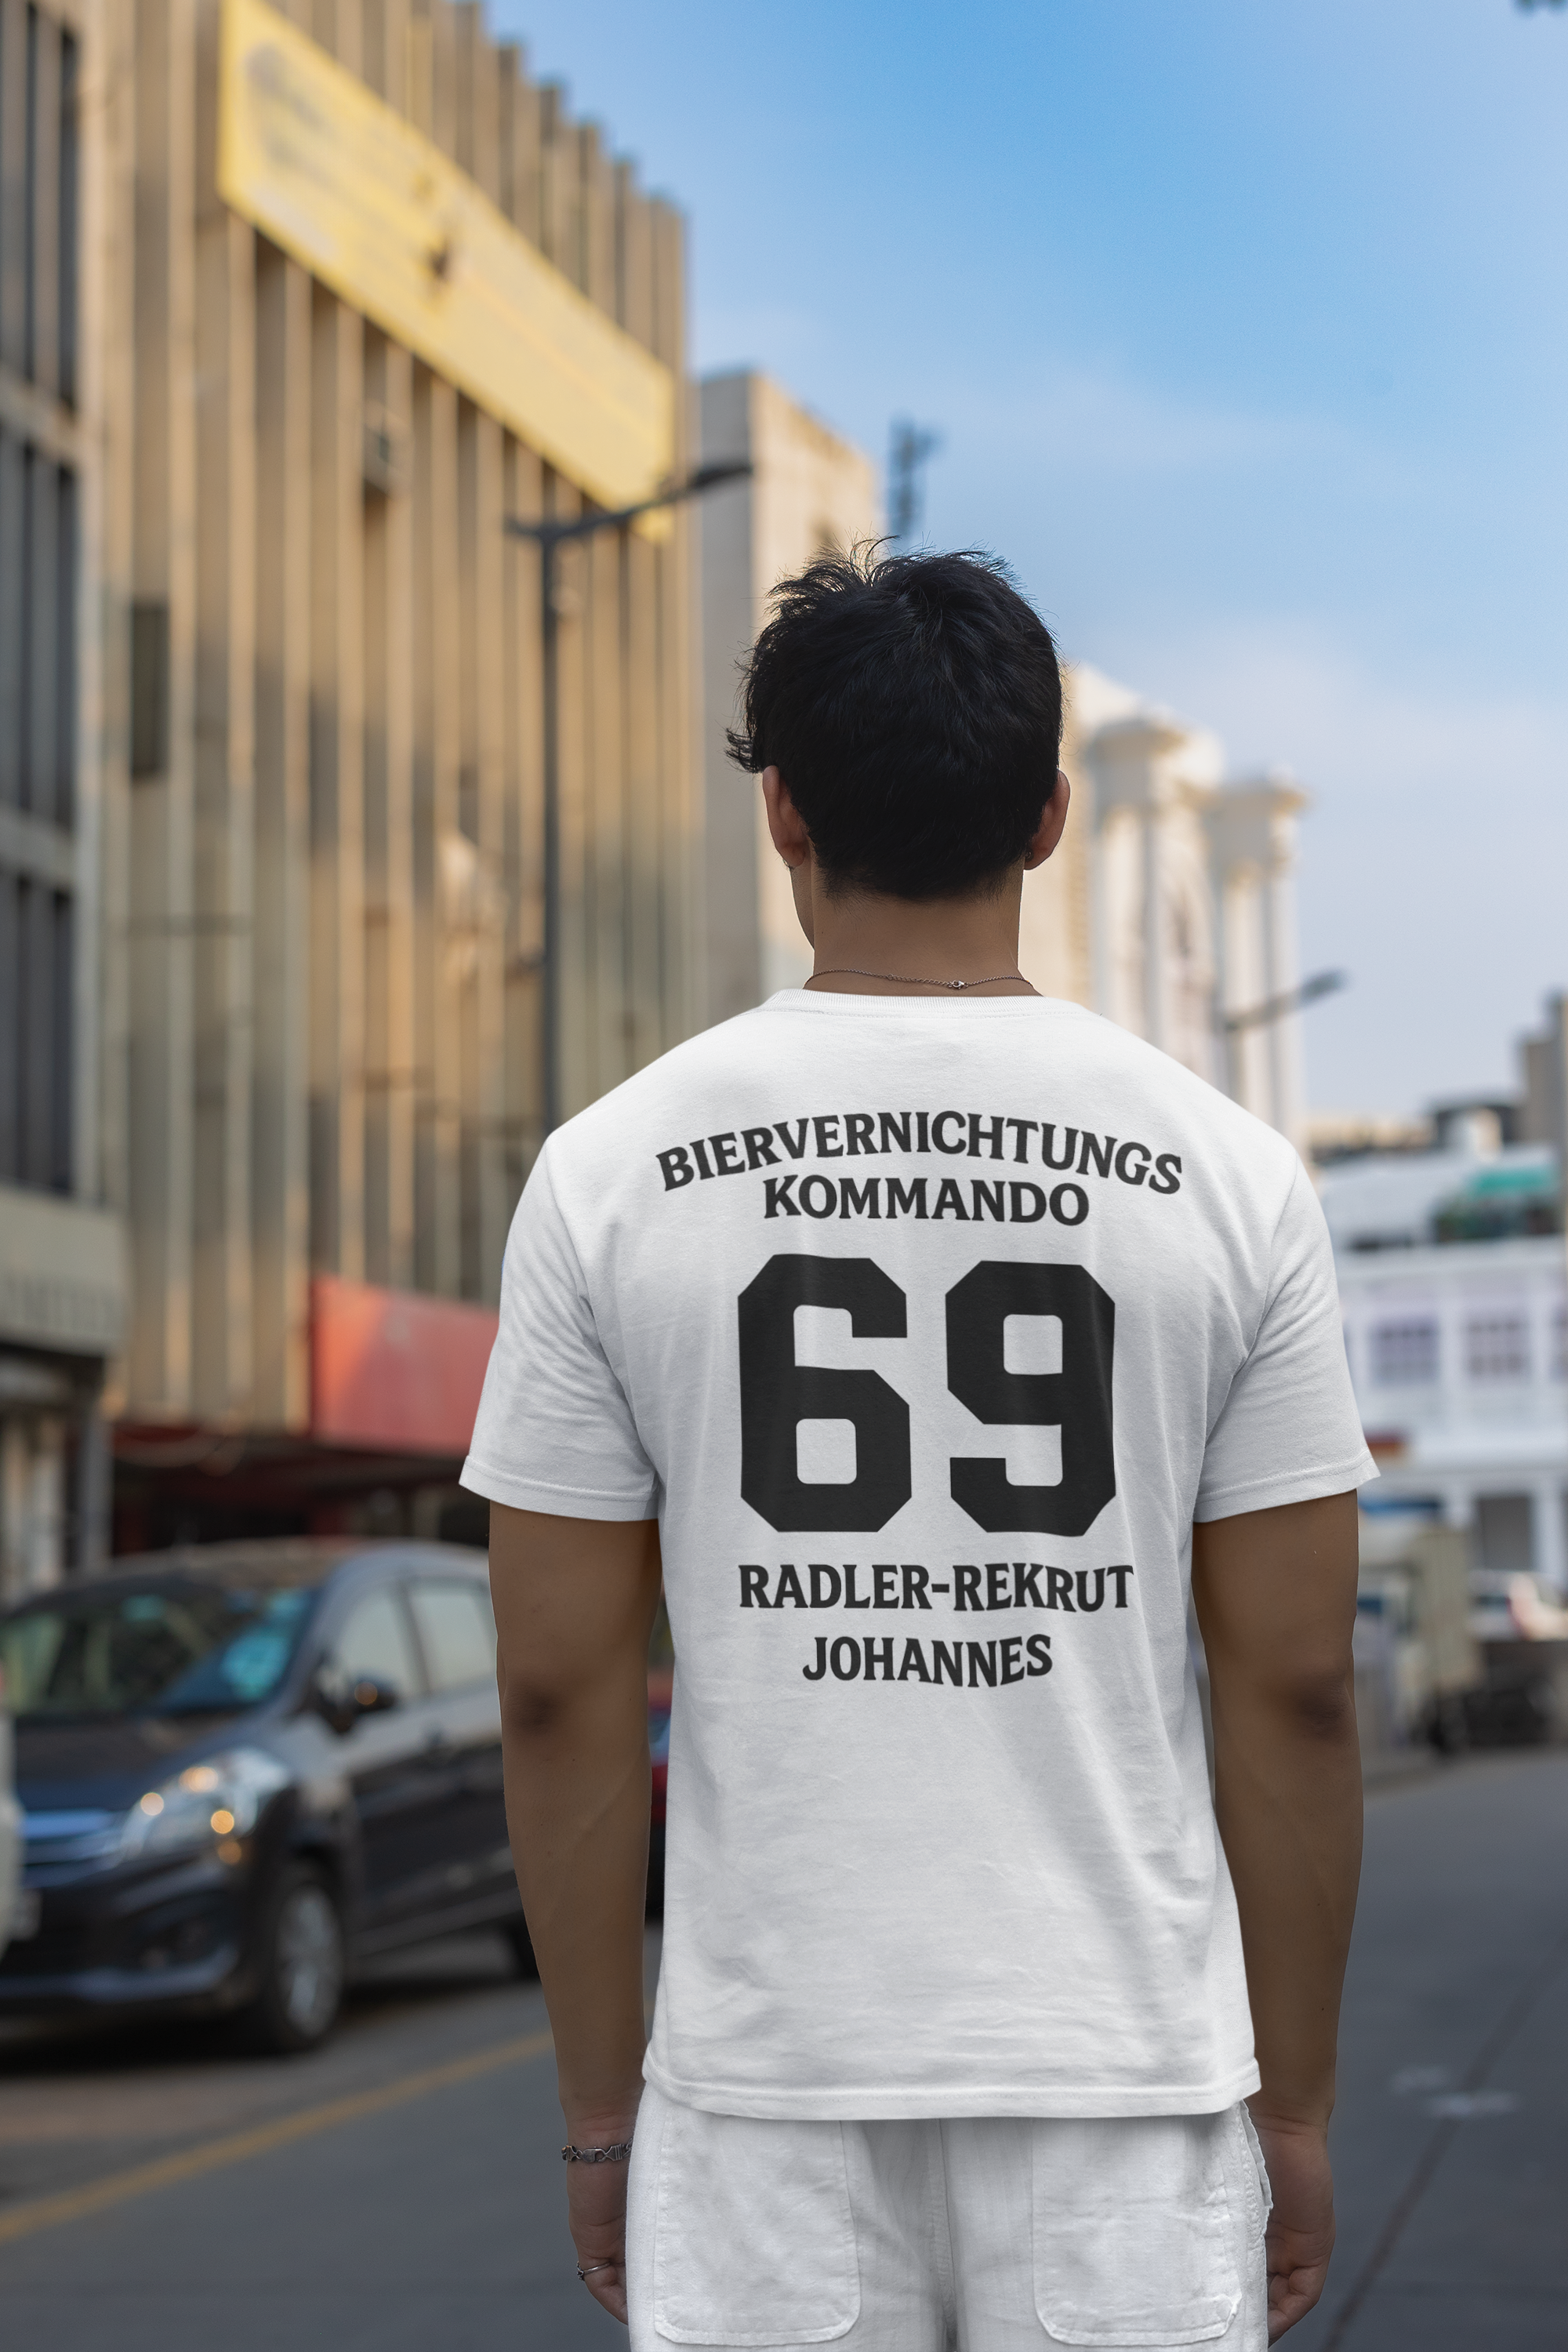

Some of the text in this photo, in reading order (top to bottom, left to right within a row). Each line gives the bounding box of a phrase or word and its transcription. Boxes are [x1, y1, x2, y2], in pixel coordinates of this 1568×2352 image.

[656, 1111, 1182, 1194] BIERVERNICHTUNGS
[763, 1174, 1089, 1226] KOMMANDO
[738, 1254, 1116, 1537] 69
[738, 1563, 1134, 1613] RADLER-REKRUT
[802, 1634, 1053, 1688] JOHANNES
